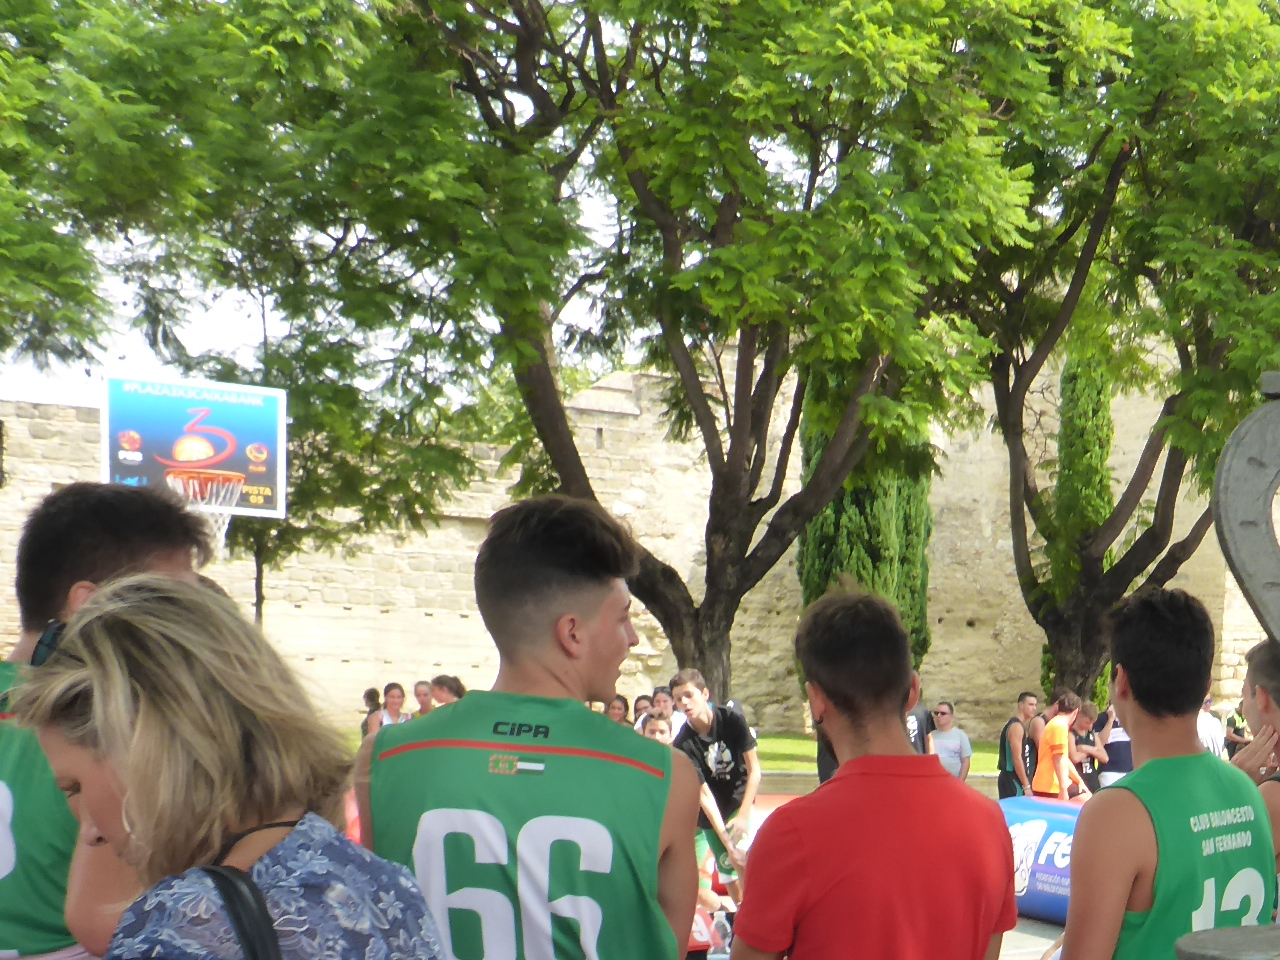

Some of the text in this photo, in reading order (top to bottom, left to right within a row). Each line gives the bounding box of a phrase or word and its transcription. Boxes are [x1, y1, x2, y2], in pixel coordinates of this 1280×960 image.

[241, 485, 272, 496] PISTA
[492, 721, 550, 739] CIPA
[1190, 814, 1211, 833] CLUB
